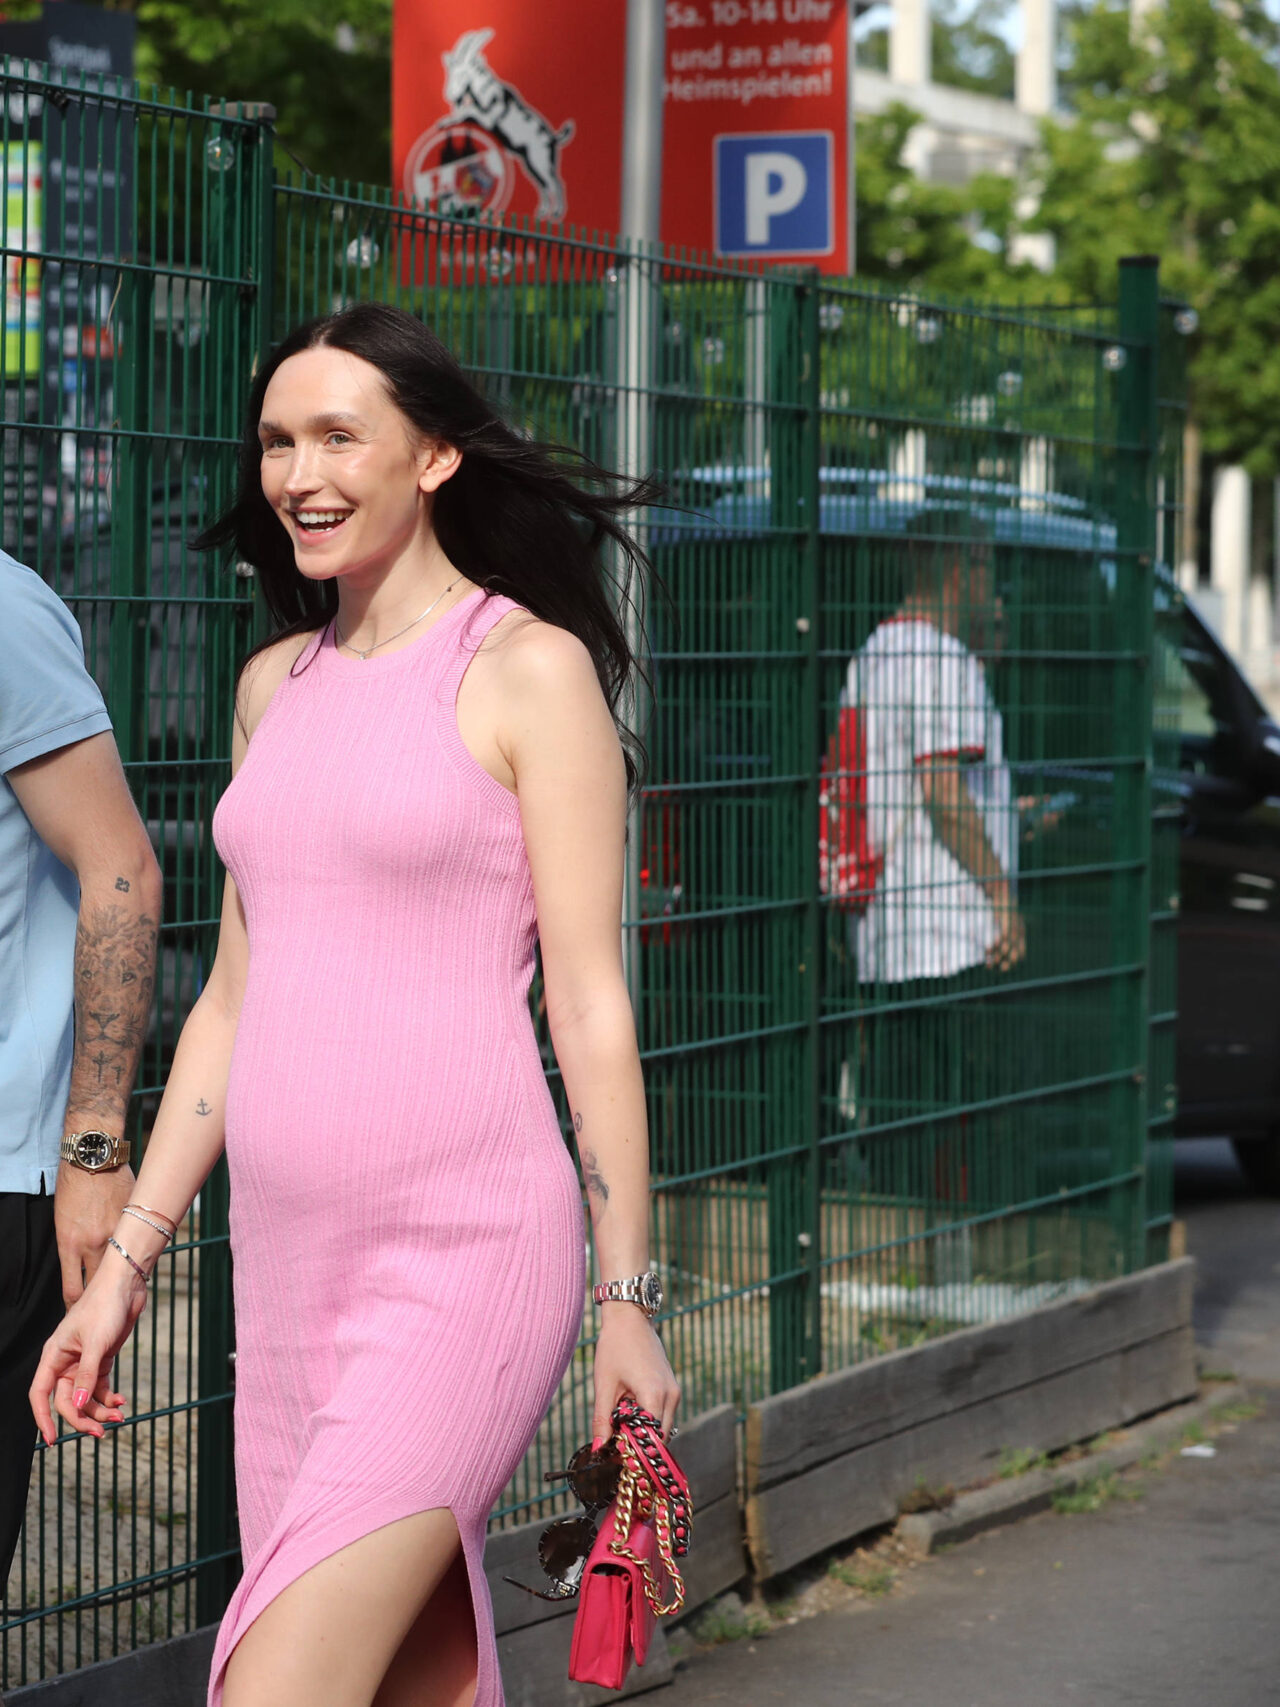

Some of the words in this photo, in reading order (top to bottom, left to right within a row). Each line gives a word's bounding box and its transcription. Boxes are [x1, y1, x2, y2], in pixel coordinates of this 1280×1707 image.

[710, 0, 777, 26] 10-14
[783, 0, 832, 23] Uhr
[672, 41, 723, 71] und
[728, 46, 762, 69] an
[767, 38, 833, 67] allen
[745, 152, 807, 245] P
